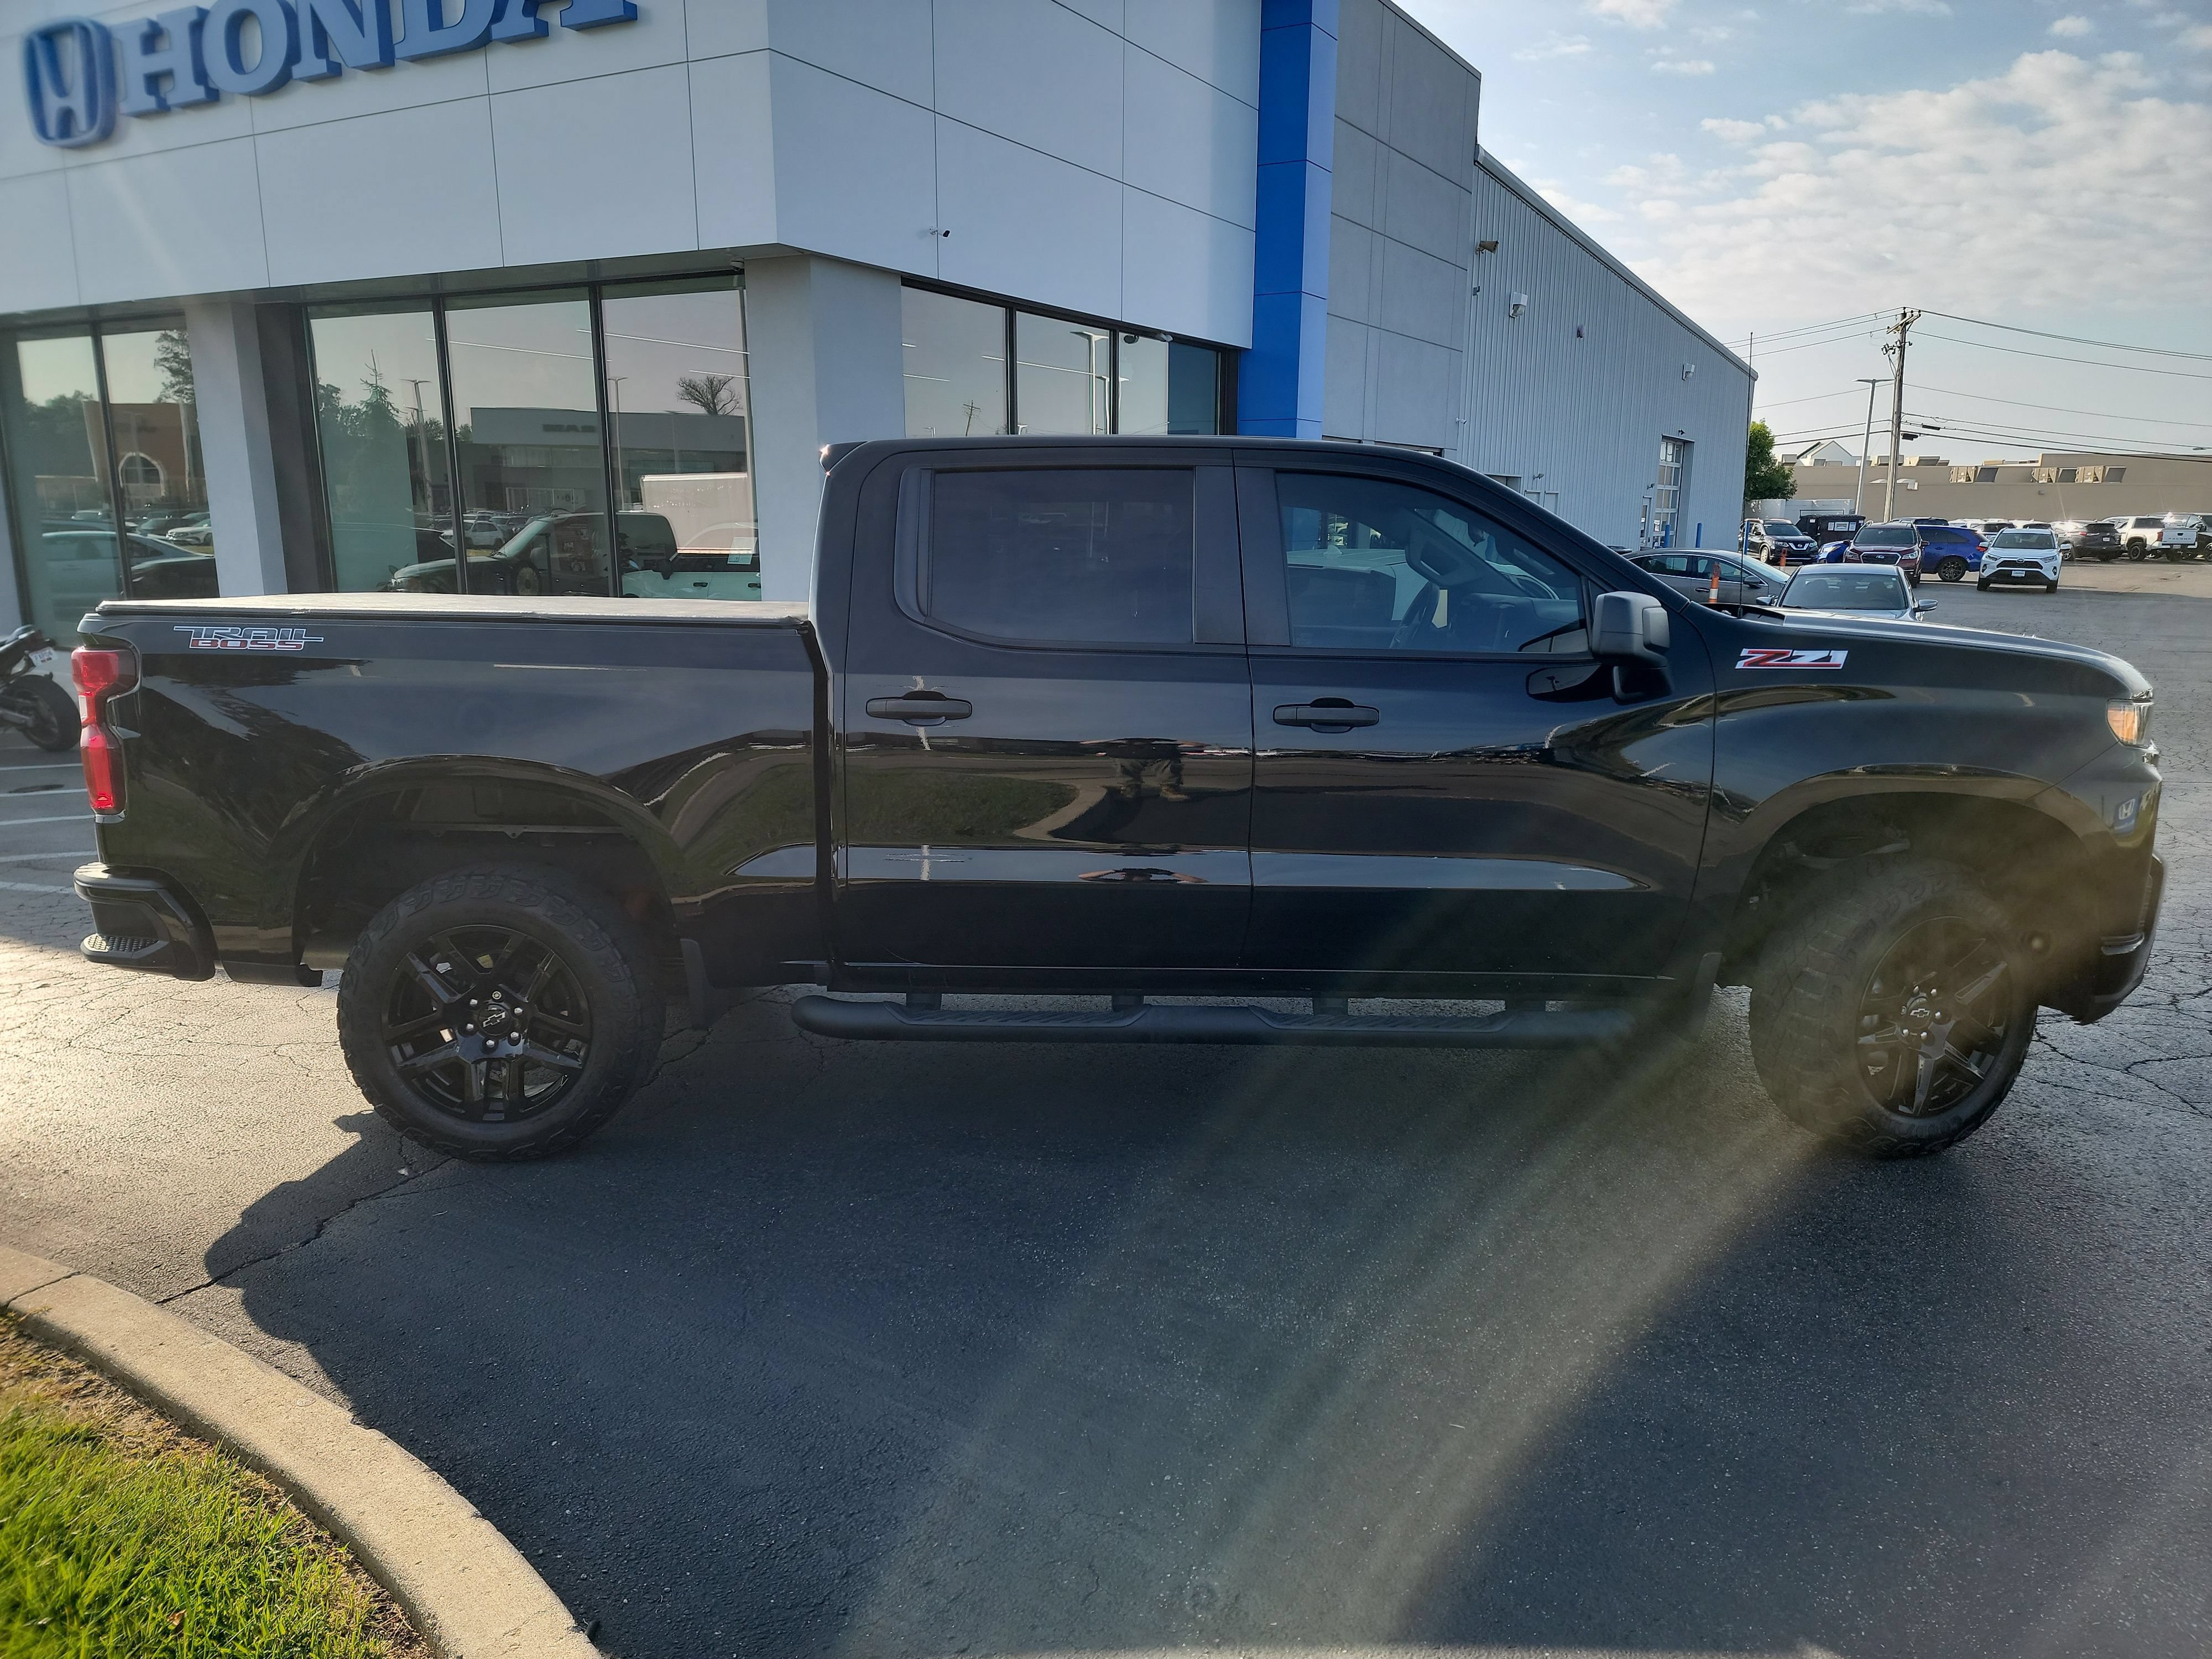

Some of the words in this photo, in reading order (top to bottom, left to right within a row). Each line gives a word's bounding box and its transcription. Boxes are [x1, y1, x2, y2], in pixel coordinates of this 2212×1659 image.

[173, 625, 324, 643] TRAIL
[189, 638, 305, 651] BOSS
[1735, 648, 1849, 670] Z71
